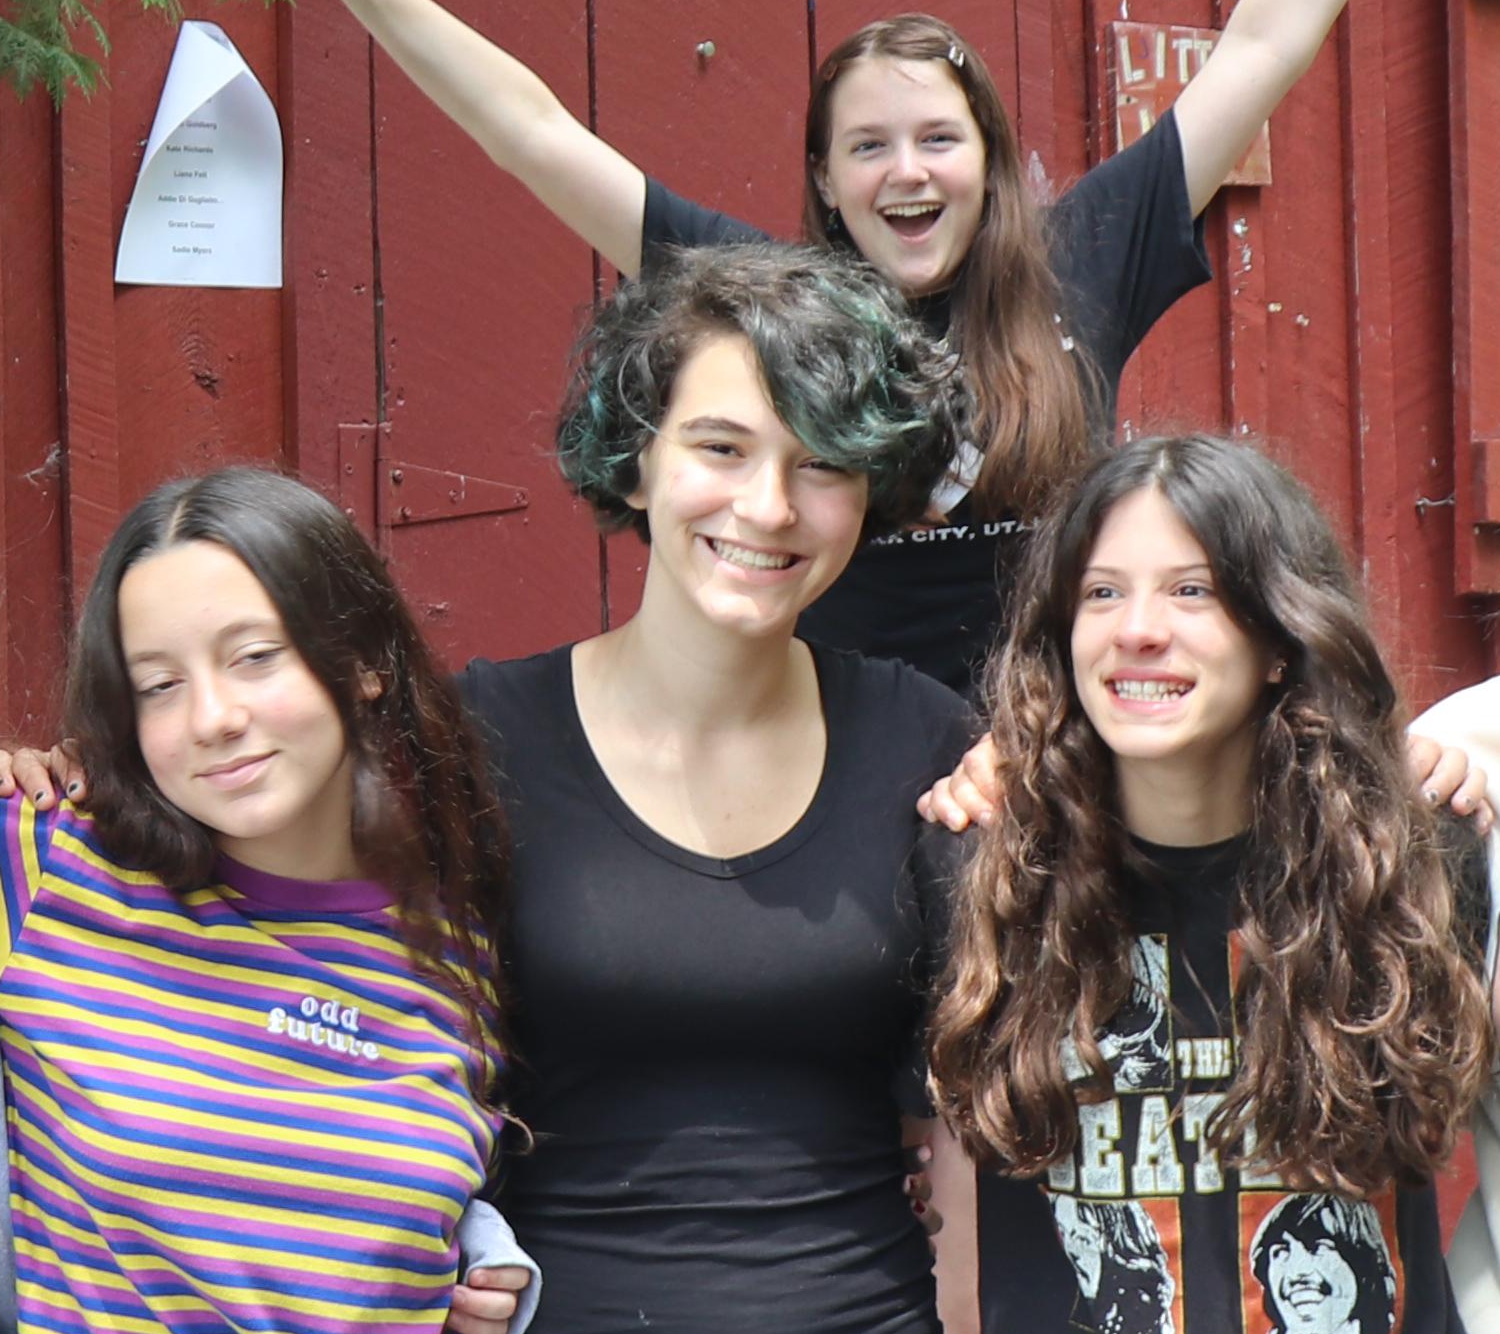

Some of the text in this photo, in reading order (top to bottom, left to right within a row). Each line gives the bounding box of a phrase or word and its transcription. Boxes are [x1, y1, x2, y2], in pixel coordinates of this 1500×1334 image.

[1119, 31, 1213, 84] LITT
[911, 526, 975, 543] CITY,
[266, 1006, 380, 1060] future
[300, 996, 360, 1033] odd
[1175, 1036, 1234, 1079] THE
